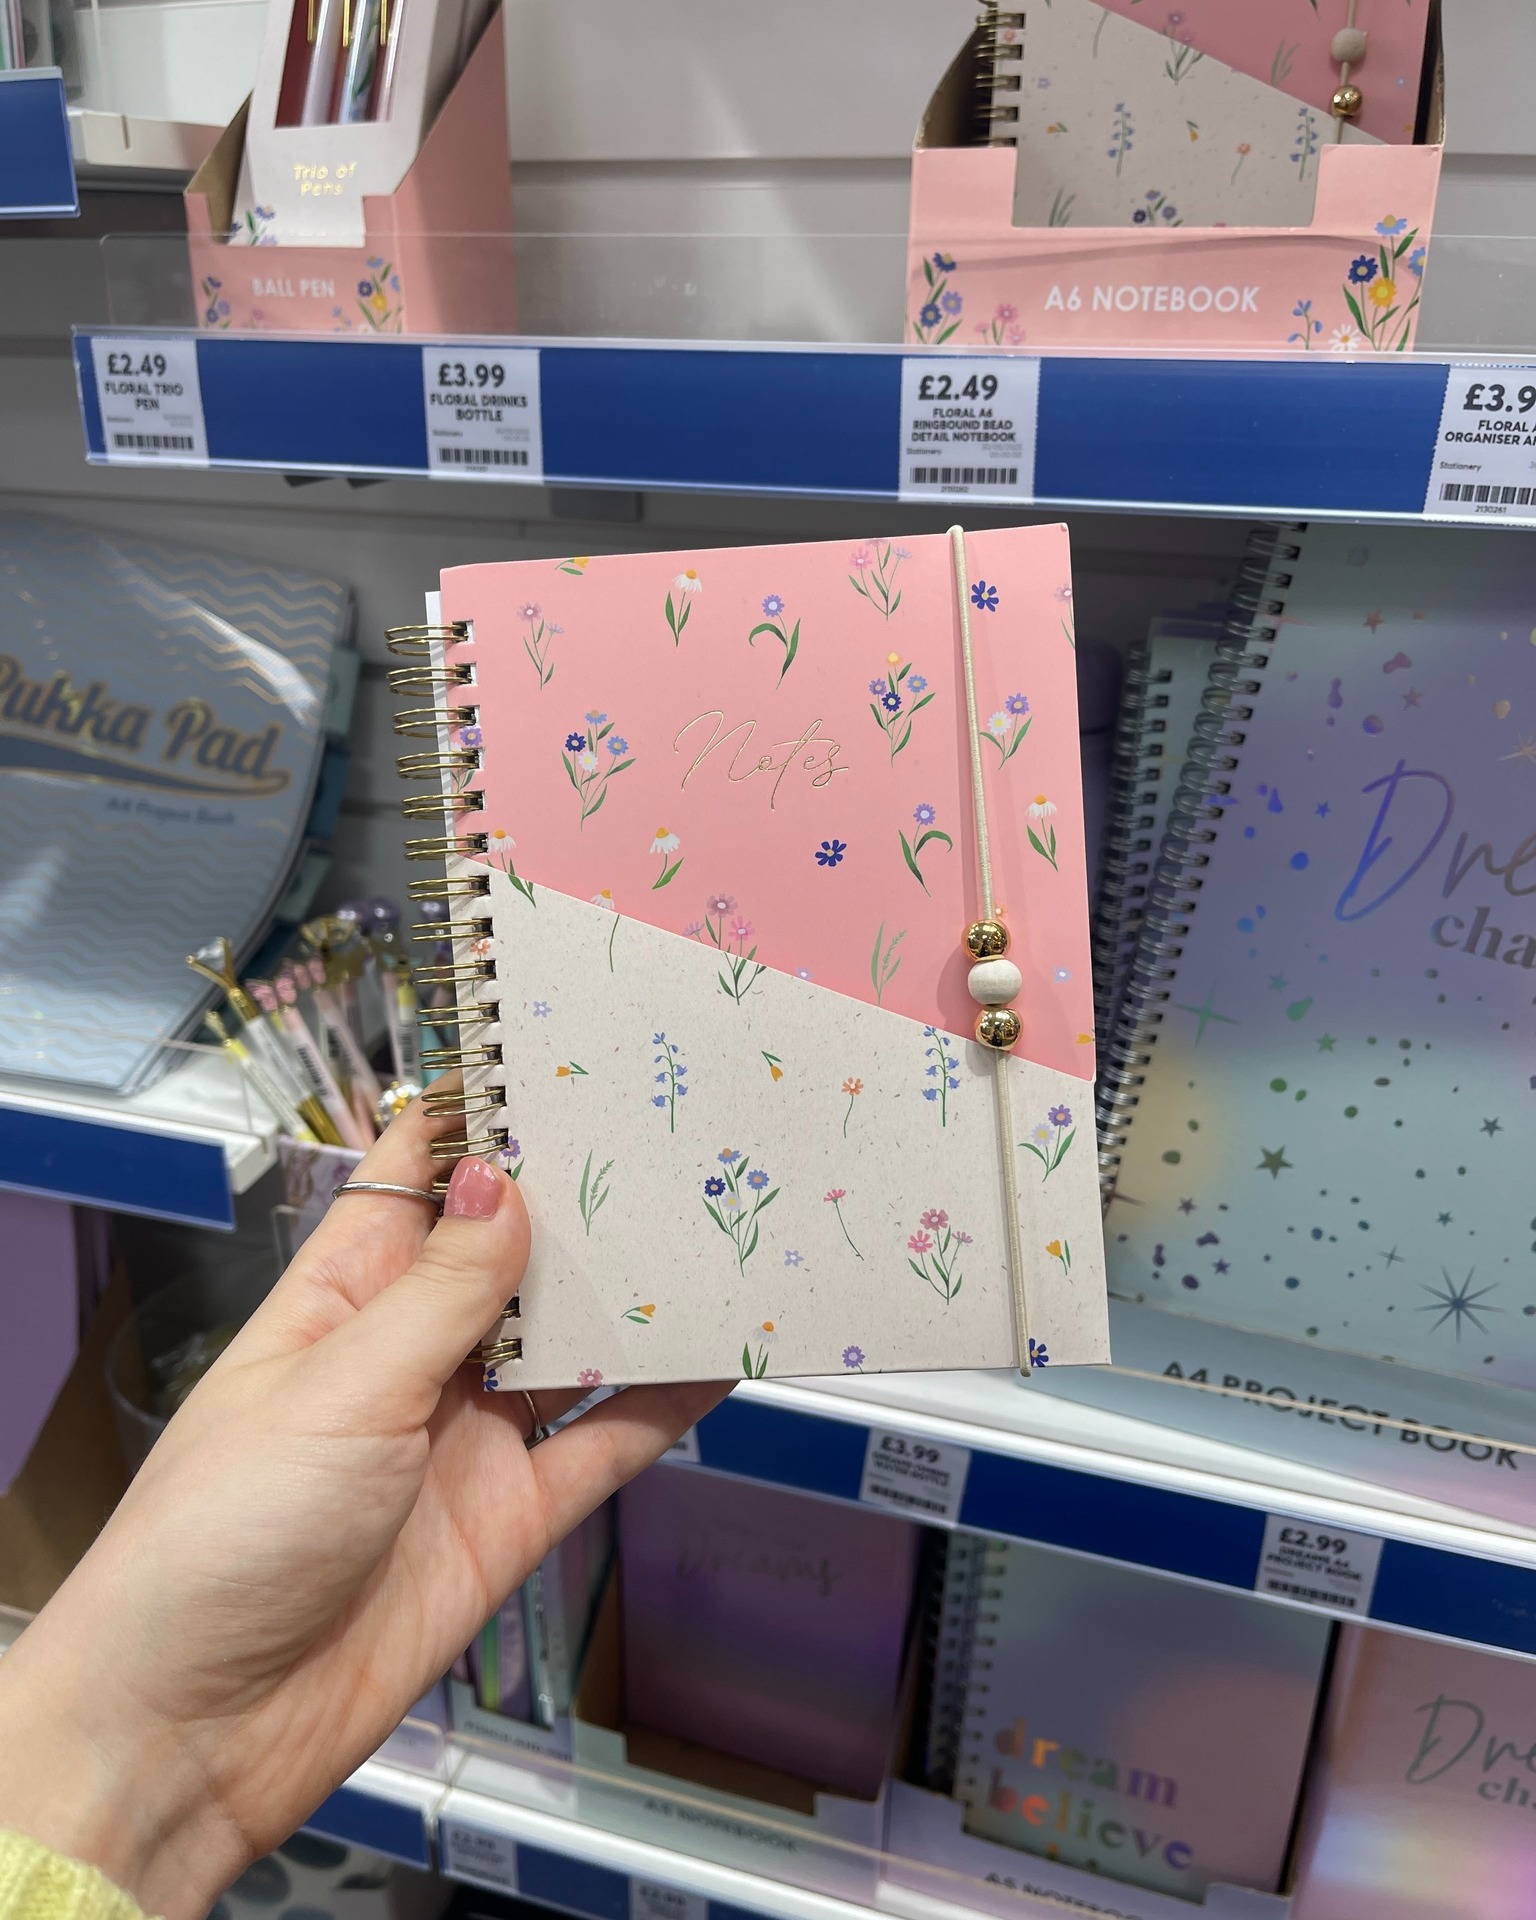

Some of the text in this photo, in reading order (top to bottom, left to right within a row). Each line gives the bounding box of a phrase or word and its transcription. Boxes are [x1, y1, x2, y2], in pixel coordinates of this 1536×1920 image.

[293, 160, 357, 180] Trio of
[300, 180, 343, 197] Pens
[252, 277, 336, 298] BALL PEN
[1044, 285, 1260, 313] A6 NOTEBOOK
[107, 353, 167, 377] £2.49
[439, 363, 505, 387] £3.99
[104, 382, 184, 397] FLORAL TRIO
[918, 374, 998, 401] £2.49
[1463, 383, 1536, 414] £3.9
[135, 398, 160, 411] PEN
[430, 393, 528, 408] FLORAL DRINKS
[456, 408, 503, 422] BOTTLE
[932, 408, 993, 419] FLORAL A6
[912, 419, 1013, 431] RINGBOUND BEAD
[1477, 419, 1528, 433] FLORAL
[911, 432, 1016, 442] DETAIL NOTEBOOK
[1444, 431, 1520, 446] ORGANISER
[1439, 460, 1482, 472] Stationery
[162, 698, 283, 778] Pad
[673, 709, 849, 811] Notes
[1430, 905, 1536, 970] cha
[1163, 1360, 1519, 1471] A4 PROJECT BOOK
[1279, 1527, 1348, 1555] £2.99
[994, 1716, 1178, 1808] dream
[1477, 1776, 1536, 1810] ch
[989, 1766, 1194, 1870] believe
